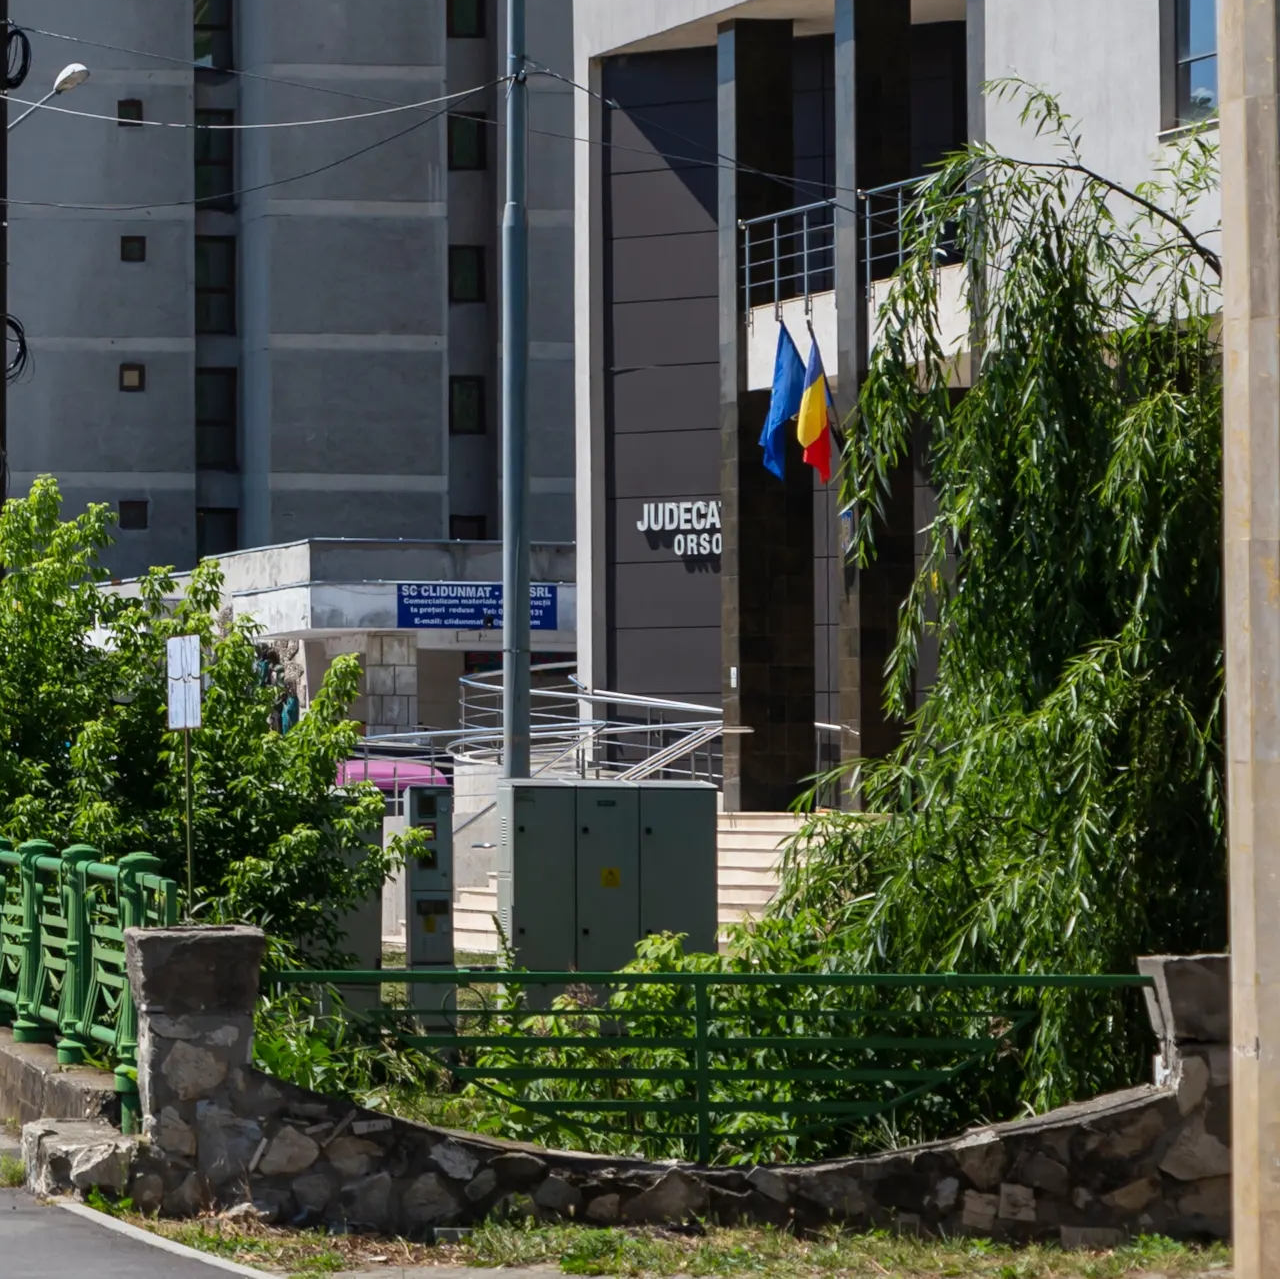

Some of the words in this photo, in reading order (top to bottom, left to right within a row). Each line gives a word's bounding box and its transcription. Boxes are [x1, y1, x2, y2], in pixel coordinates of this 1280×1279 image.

[636, 501, 721, 531] JUDECA
[402, 585, 418, 596] SC
[421, 585, 492, 597] CLIDUNMAT
[529, 587, 552, 597] SRL
[403, 597, 460, 605] Comercializam
